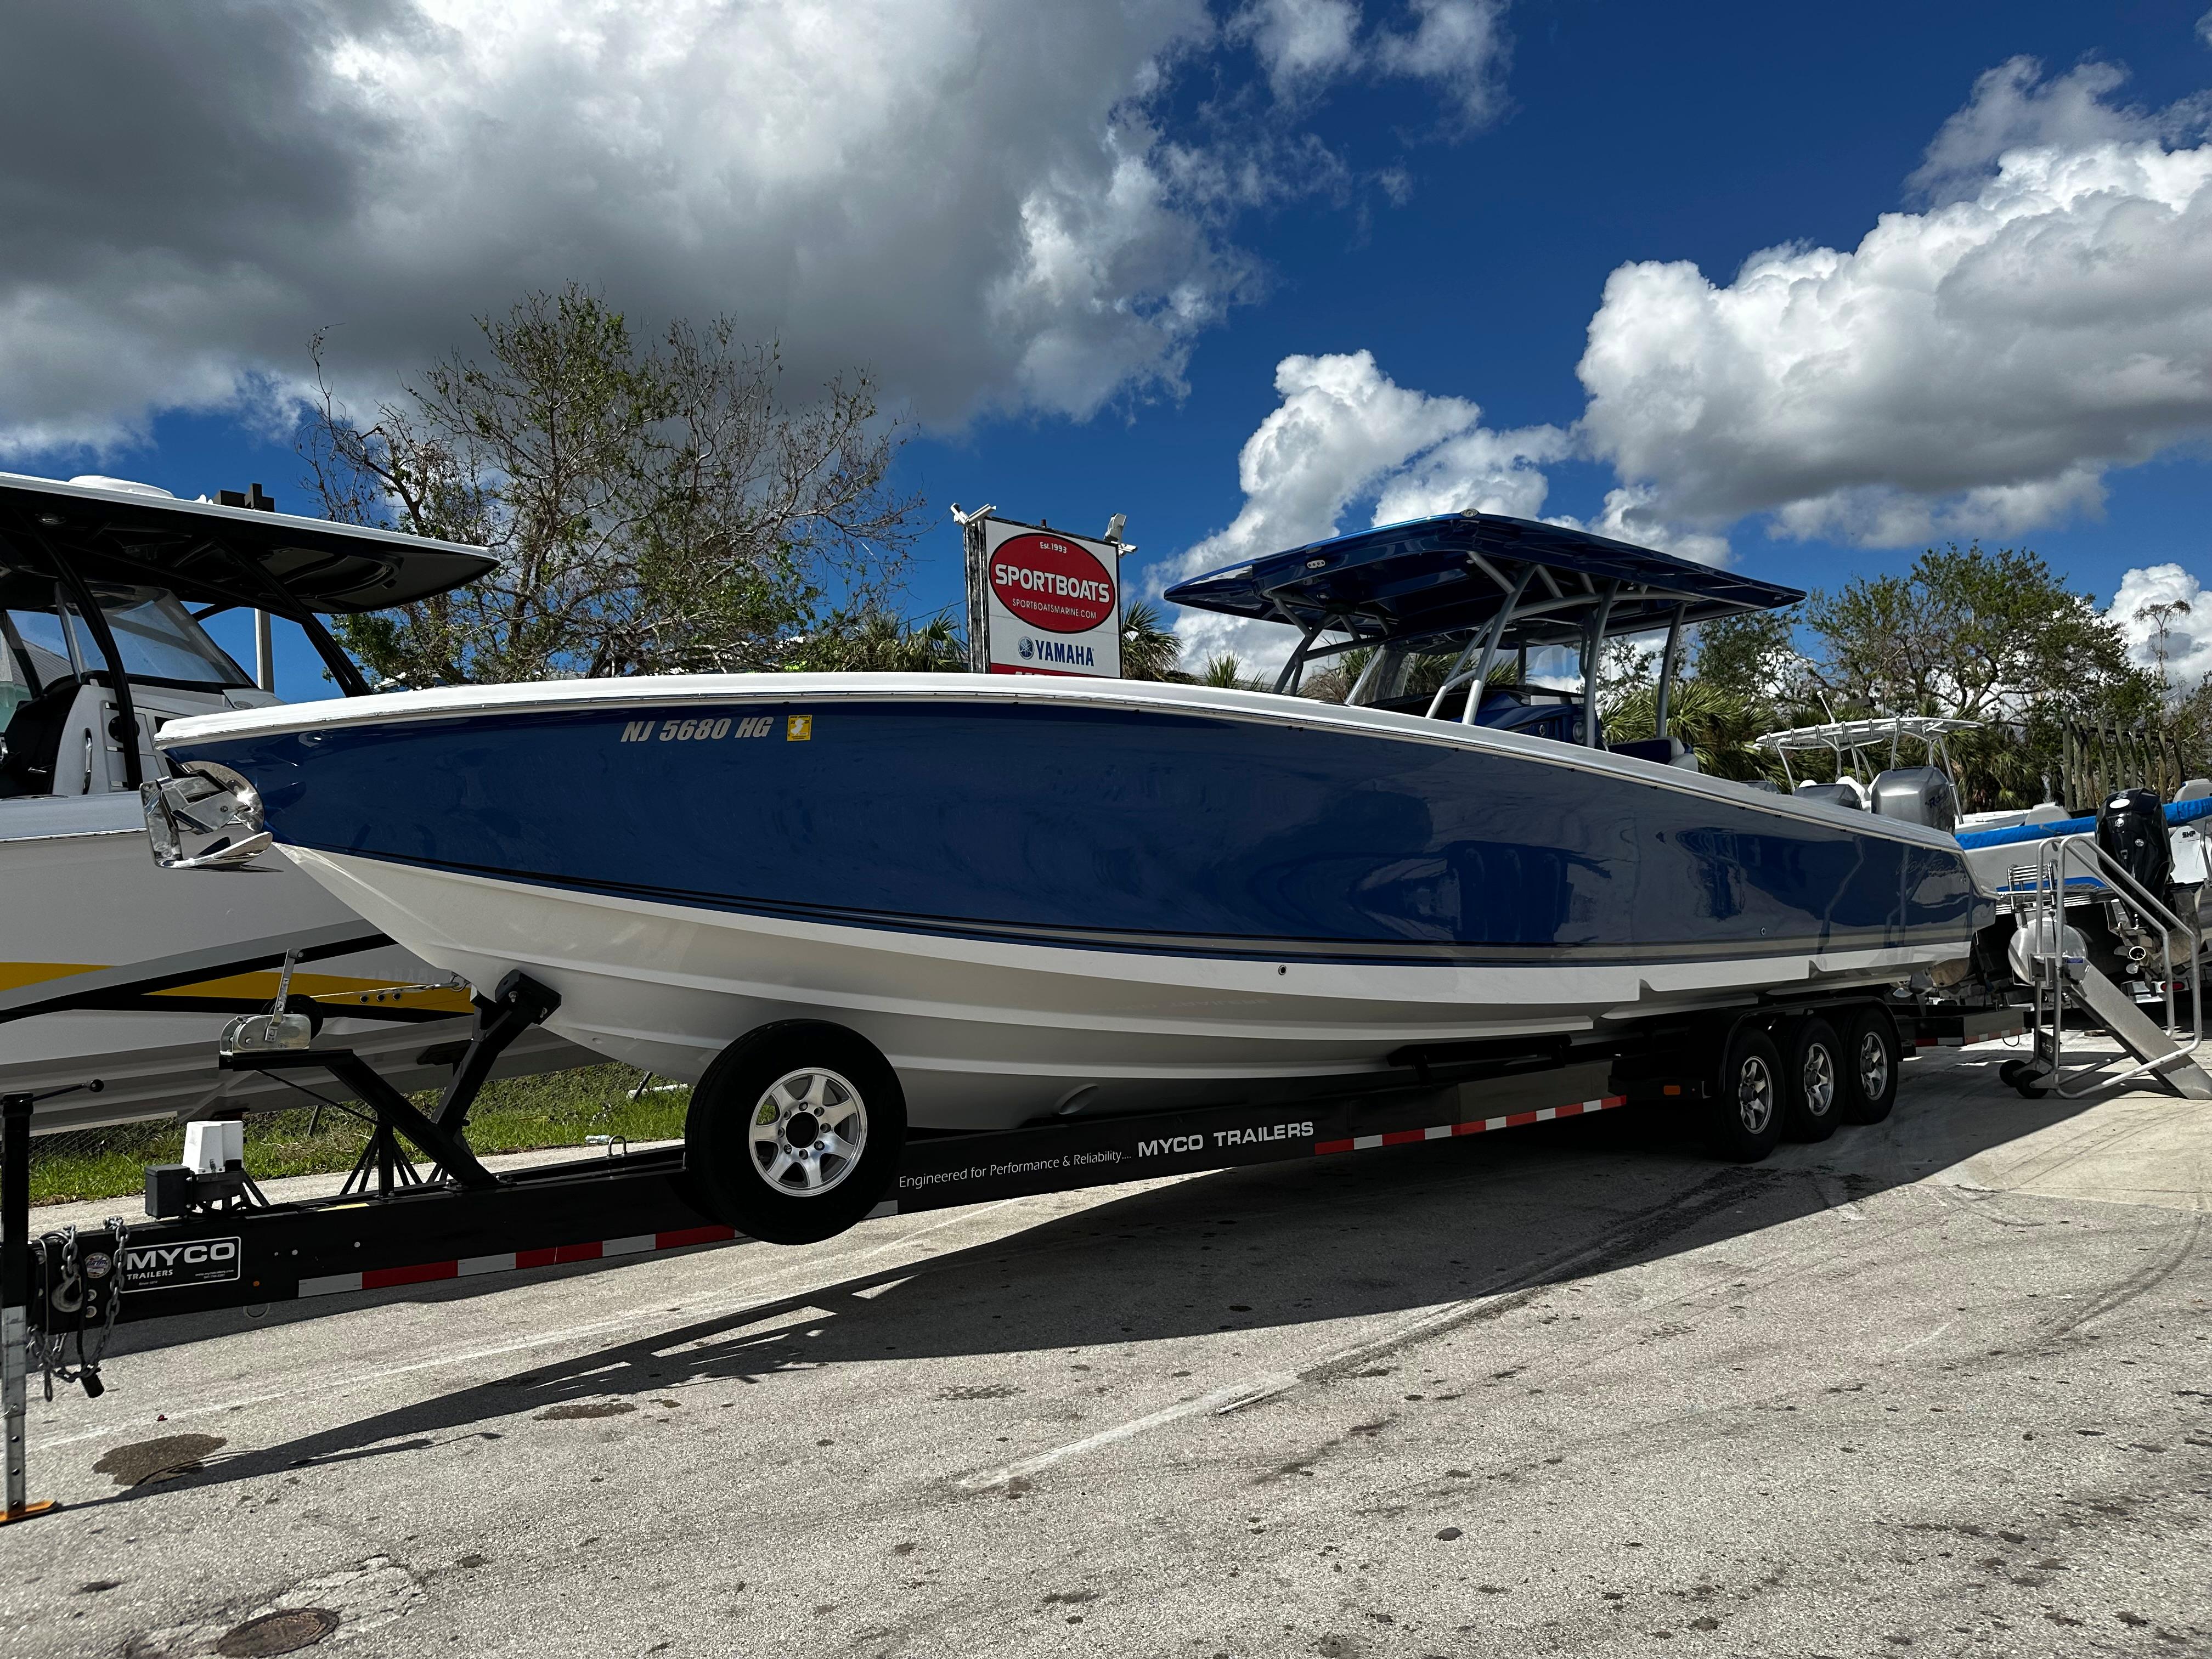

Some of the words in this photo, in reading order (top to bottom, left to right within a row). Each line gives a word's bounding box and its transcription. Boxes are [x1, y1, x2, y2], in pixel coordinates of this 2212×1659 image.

[995, 563, 1110, 603] SPORTBOATS
[1012, 598, 1096, 619] SPORTBOATSMARINE.COM
[1035, 640, 1094, 667] YAMAHA
[620, 721, 656, 742] NJ
[659, 718, 732, 741] 5680
[735, 716, 774, 738] HG
[899, 1168, 967, 1189] Engineered
[970, 1166, 987, 1179] for
[990, 1159, 1060, 1176] Performance
[1063, 1155, 1071, 1167] &
[1138, 1135, 1203, 1157] MYCO
[1213, 1121, 1313, 1147] TRAILERS
[127, 1243, 235, 1271] MYCO
[127, 1269, 173, 1280] TRAILERS
